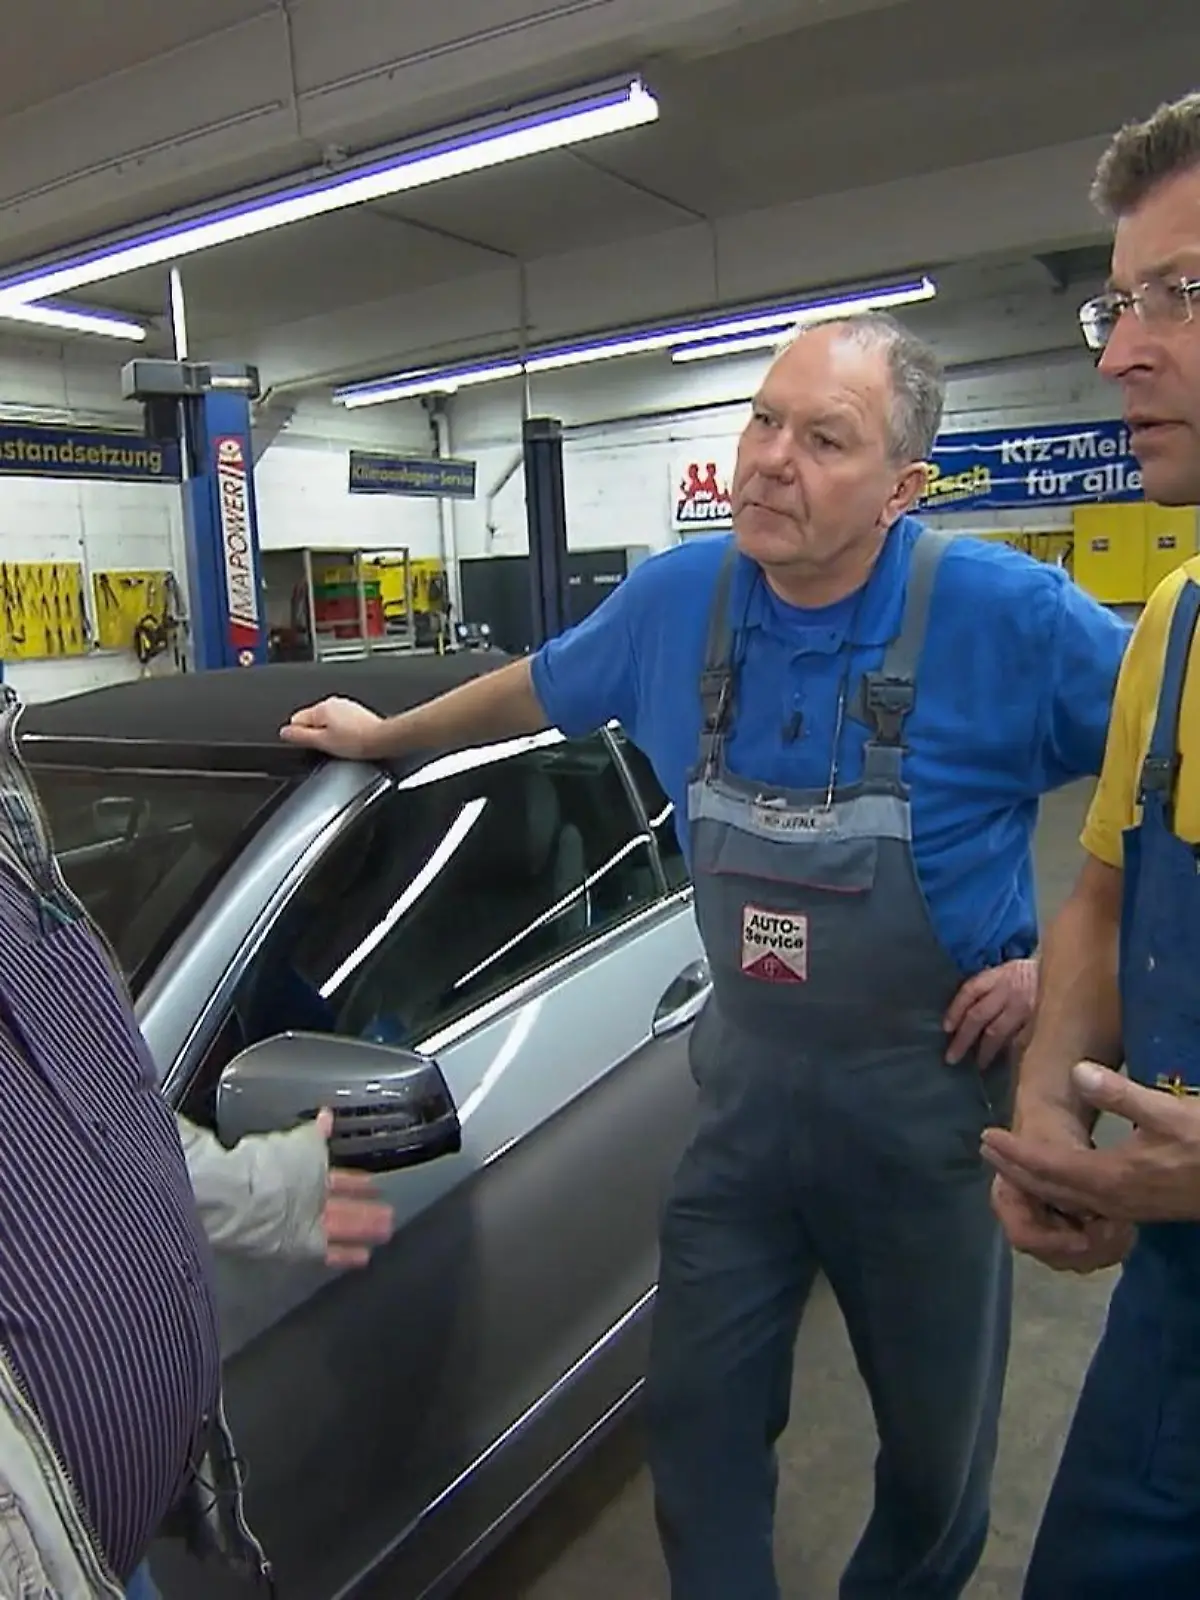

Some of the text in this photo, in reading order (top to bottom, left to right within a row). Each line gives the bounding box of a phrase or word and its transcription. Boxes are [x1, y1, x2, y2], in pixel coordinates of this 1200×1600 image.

[0, 438, 162, 474] standsetzung
[1025, 467, 1073, 496] für
[746, 926, 804, 949] Service
[750, 915, 800, 934] AUTO-
